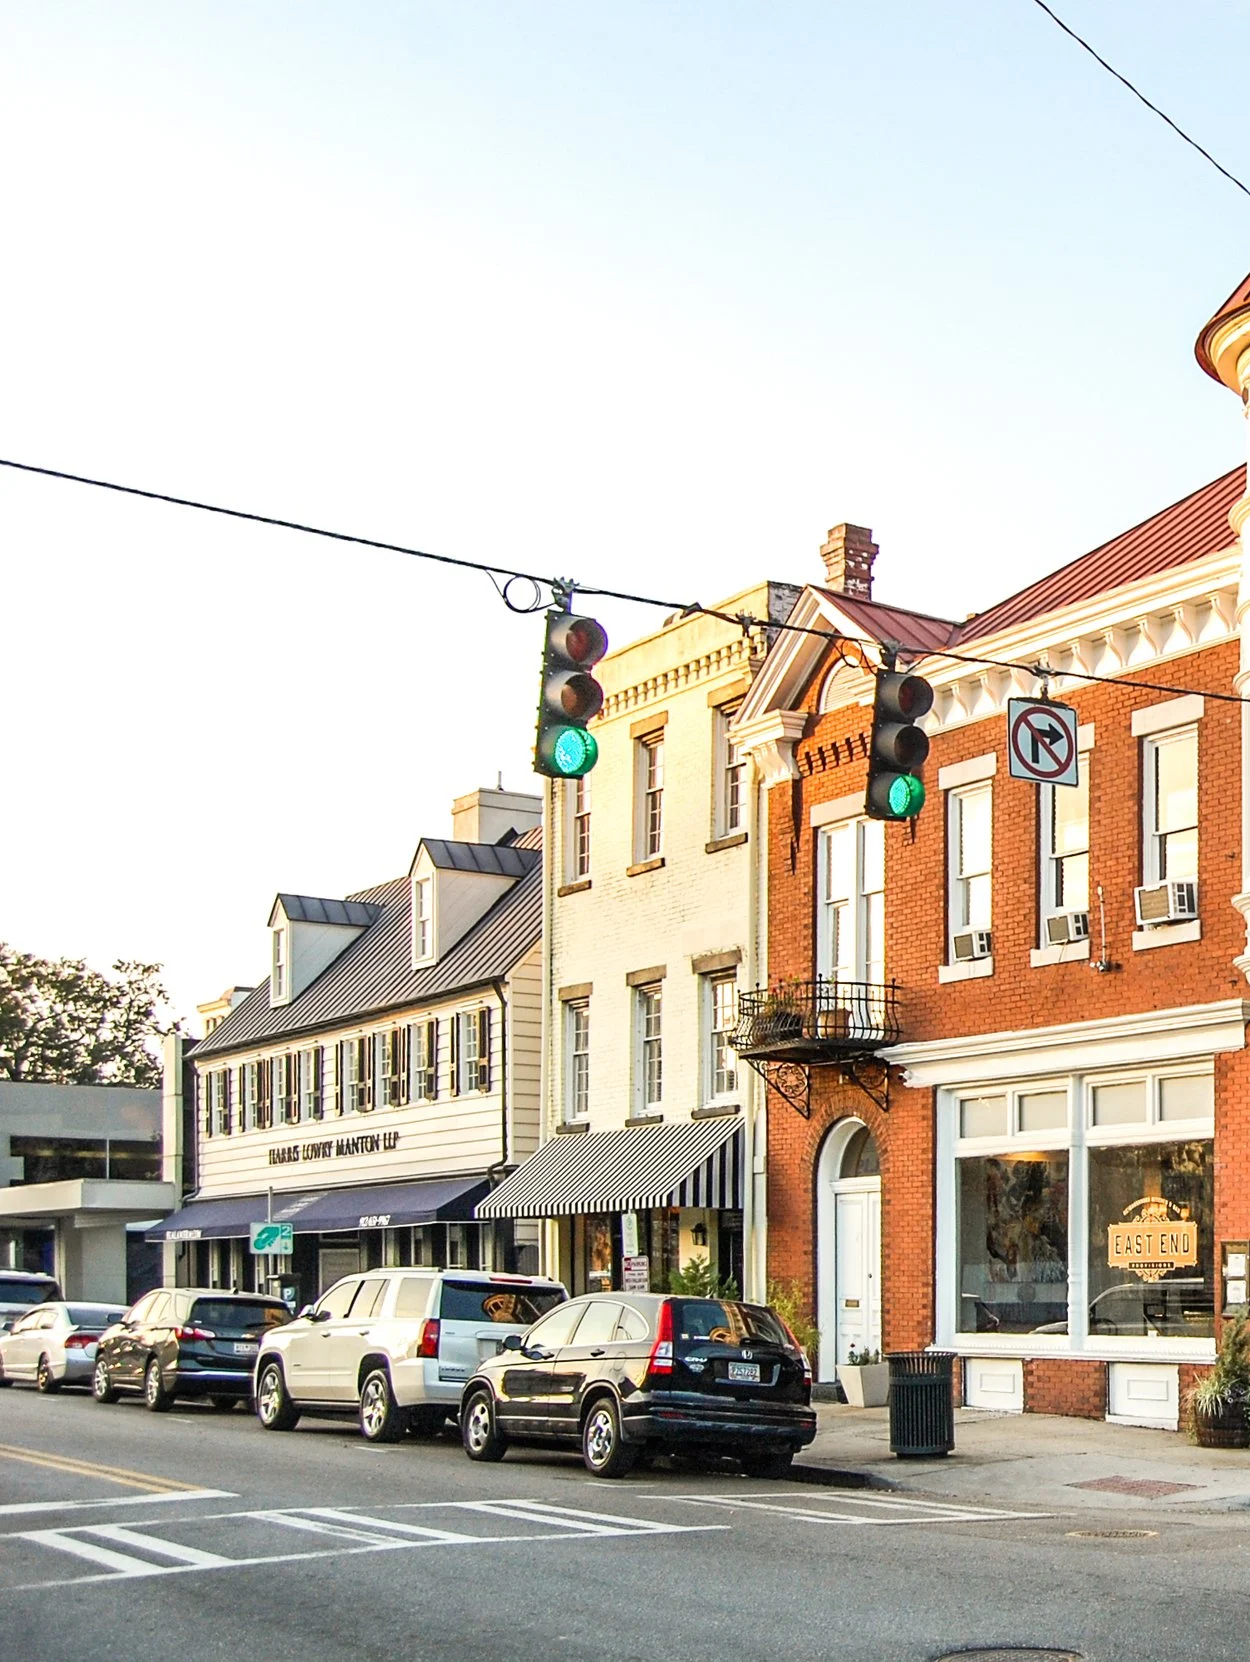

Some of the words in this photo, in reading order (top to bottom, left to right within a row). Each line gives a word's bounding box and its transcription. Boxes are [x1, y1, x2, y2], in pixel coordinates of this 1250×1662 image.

[269, 1145, 299, 1165] HARRIS
[302, 1140, 333, 1160] LOWRY
[336, 1133, 380, 1156] MANTON
[383, 1131, 400, 1150] LLP
[1115, 1234, 1152, 1254] EAST
[1161, 1233, 1189, 1253] END
